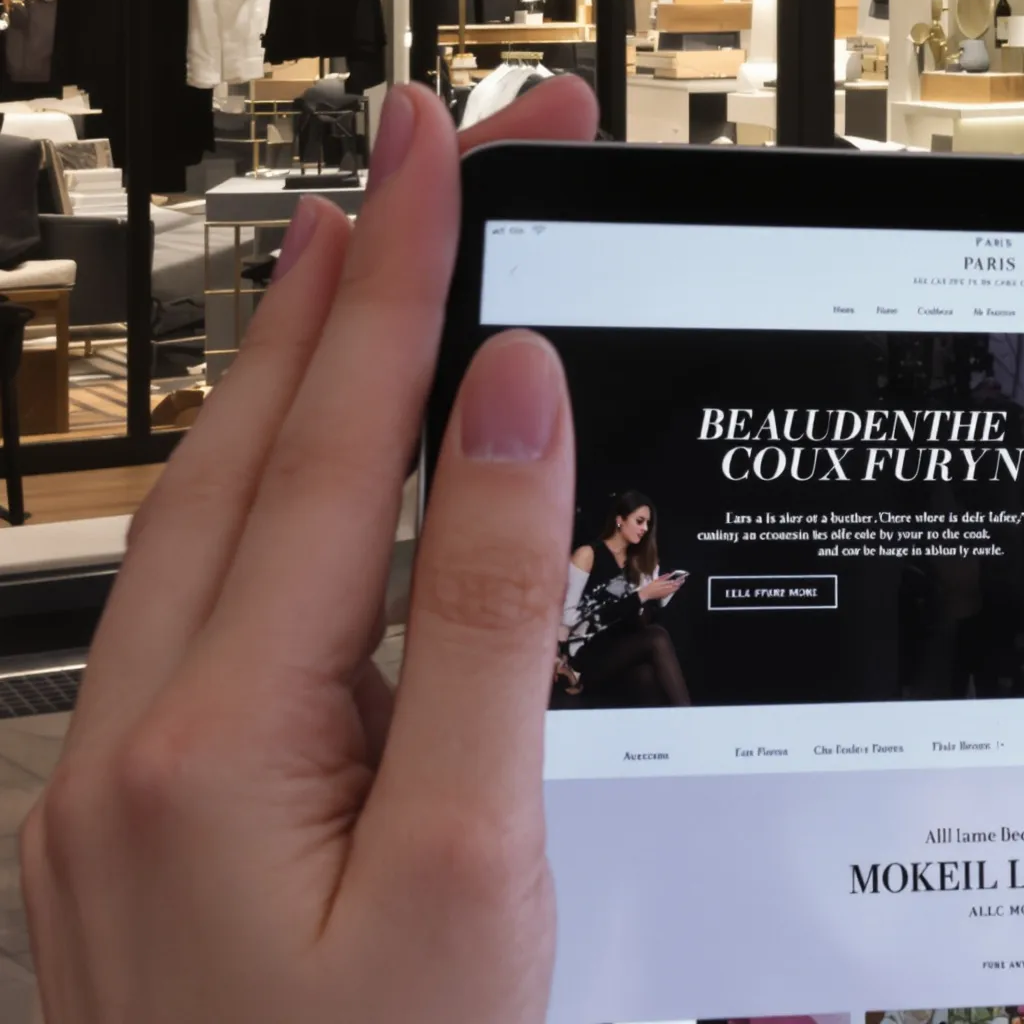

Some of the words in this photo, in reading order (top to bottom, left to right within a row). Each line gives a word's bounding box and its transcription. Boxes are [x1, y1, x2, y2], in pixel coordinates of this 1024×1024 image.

[964, 256, 1016, 271] PARIS
[721, 446, 854, 482] COUX
[818, 544, 839, 556] and
[863, 544, 876, 556] be
[850, 860, 998, 894] MOKEIL
